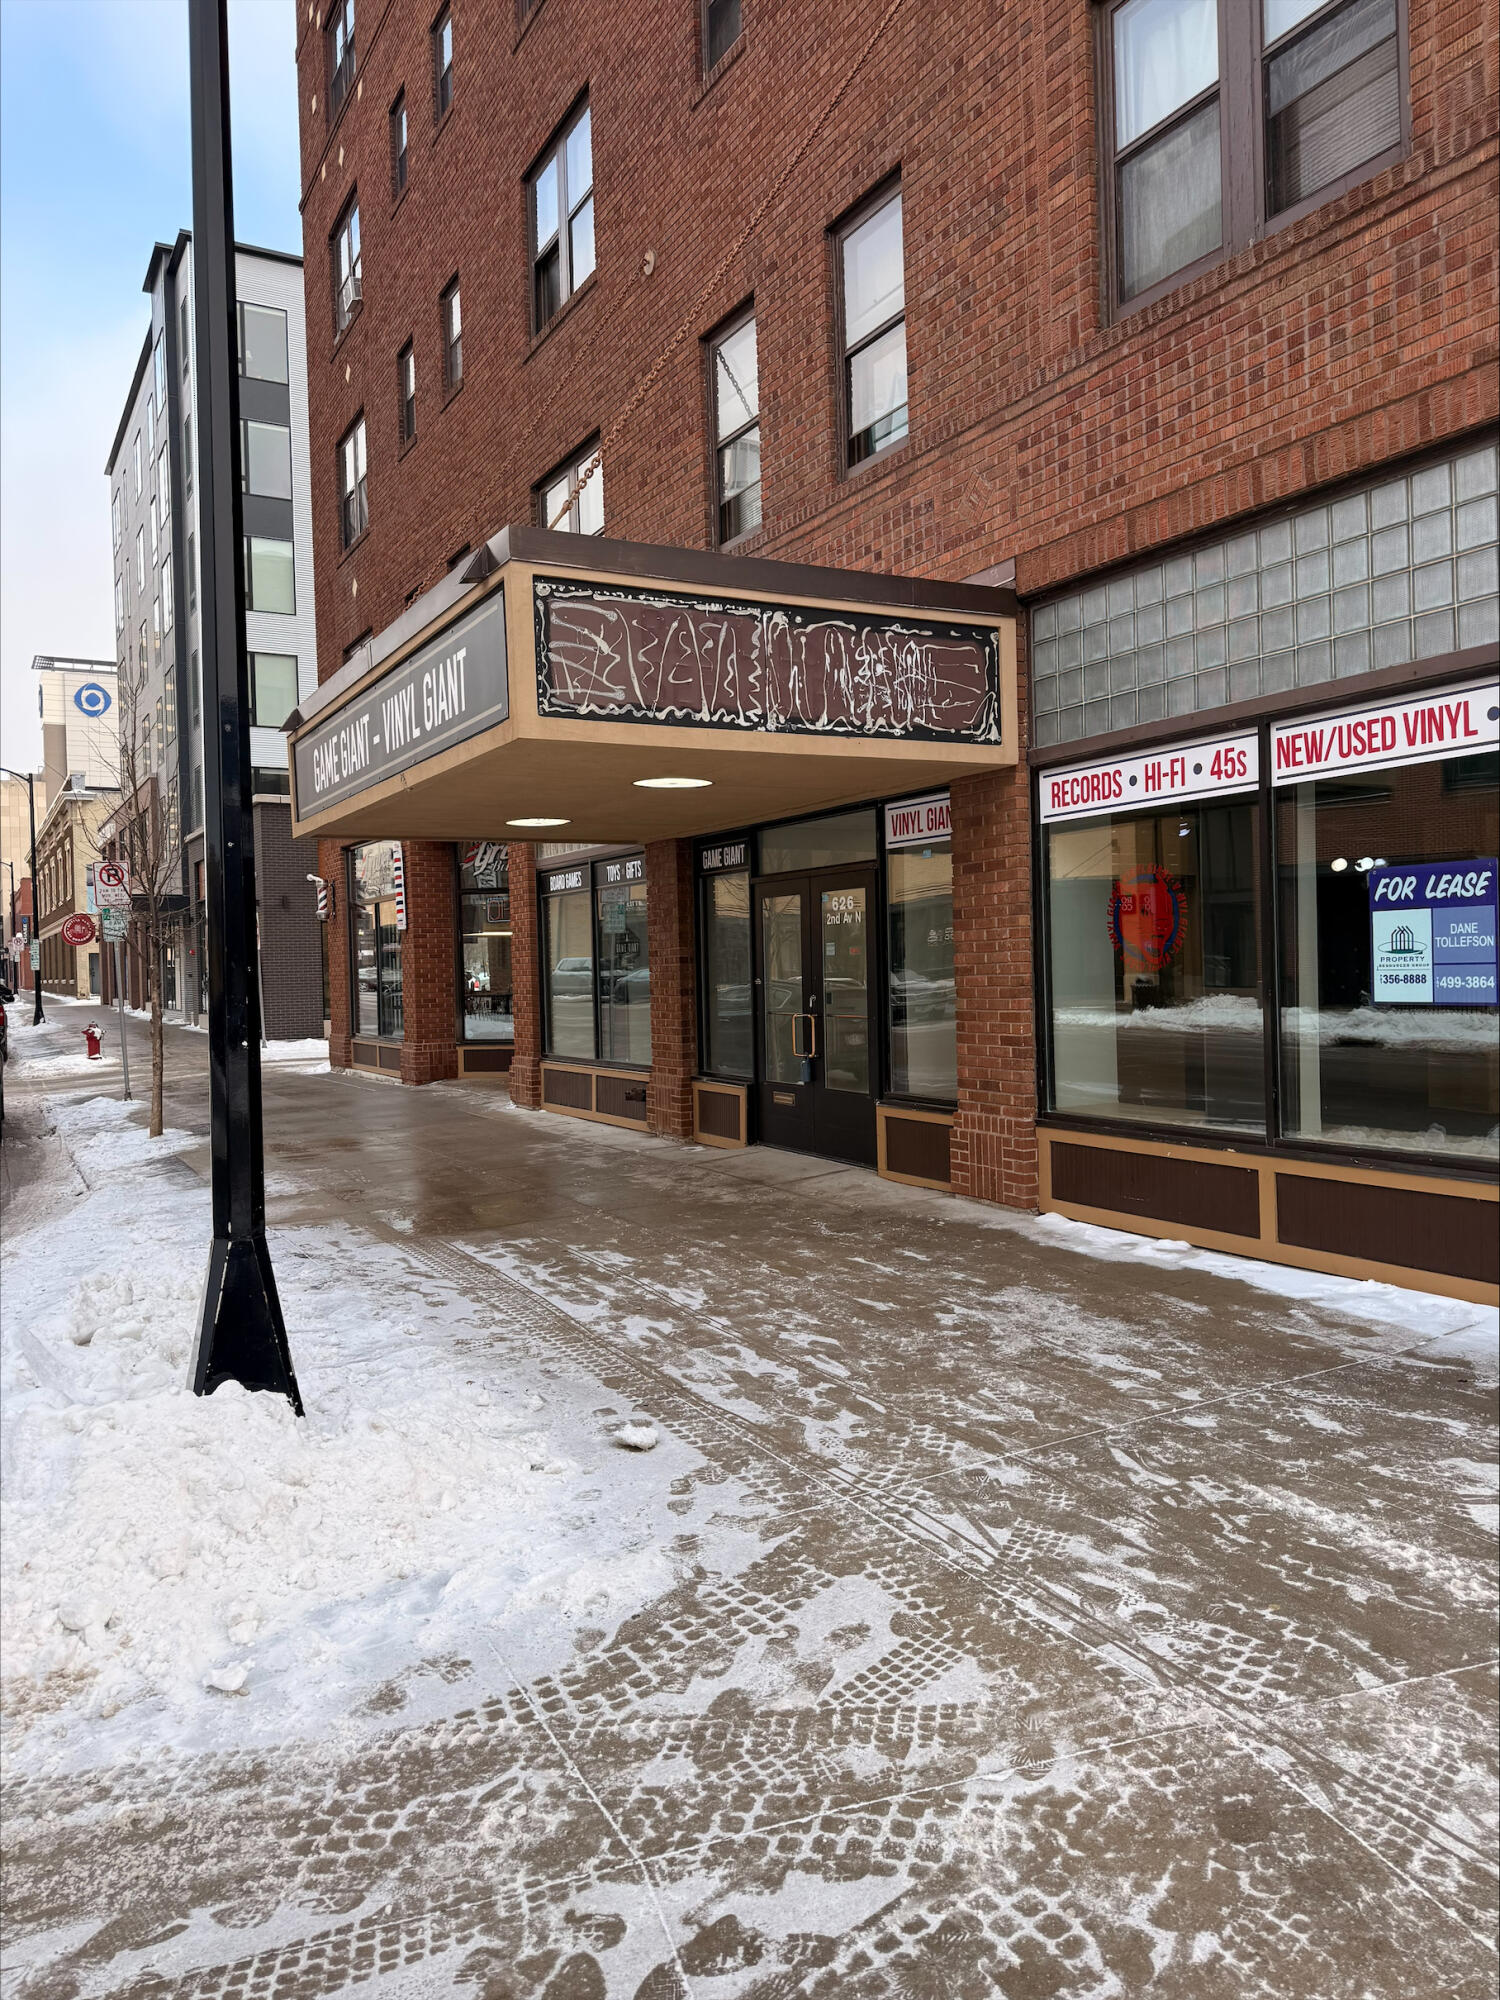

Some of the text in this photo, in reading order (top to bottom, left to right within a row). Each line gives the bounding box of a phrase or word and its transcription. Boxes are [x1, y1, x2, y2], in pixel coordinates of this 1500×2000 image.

[313, 735, 340, 793] GAME
[340, 713, 370, 778] GIANT
[382, 683, 421, 754] VINYL
[423, 647, 467, 731] GIANT
[1276, 700, 1479, 770] NEW/USED VINYL
[1051, 747, 1248, 809] RECORDS HI-FI 45s
[891, 805, 953, 837] VINYL GIAN
[702, 844, 745, 869] GAME GIANT
[549, 870, 582, 892] BOARD GAMES
[606, 860, 642, 883] TOYS GIFTS
[1374, 870, 1493, 903] FOR LEASE
[831, 896, 854, 911] 626
[826, 911, 861, 925] 2nd Av N
[1450, 922, 1479, 934] DANE
[1434, 936, 1495, 948] TOLLEFSON
[1439, 976, 1495, 989] 499-3864
